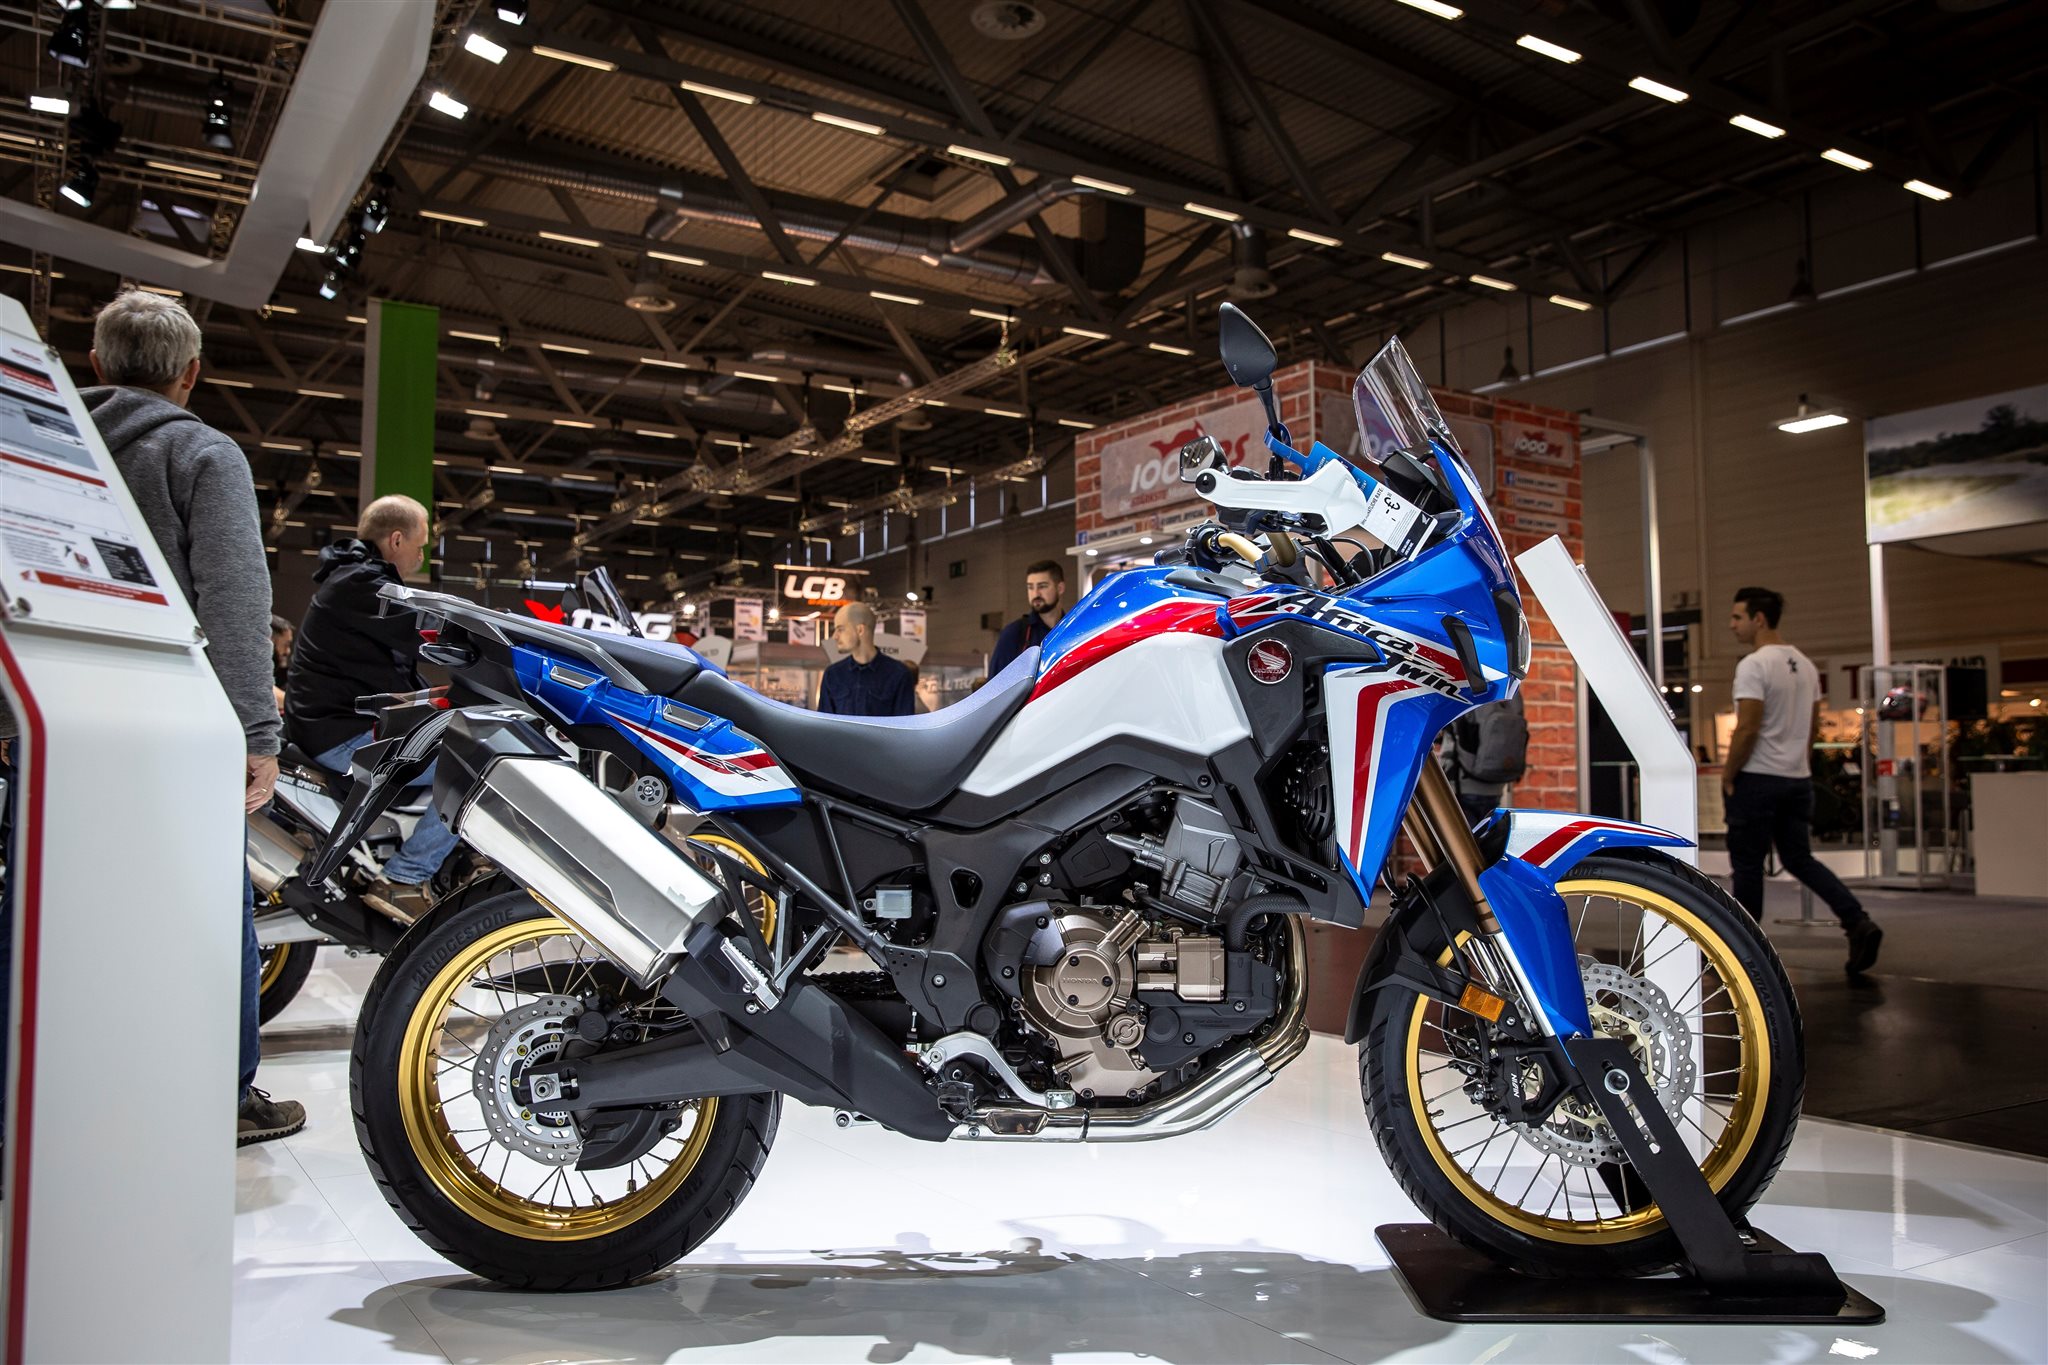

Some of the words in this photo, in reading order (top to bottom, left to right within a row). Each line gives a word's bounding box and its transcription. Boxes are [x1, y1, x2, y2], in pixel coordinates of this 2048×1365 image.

[784, 574, 846, 601] LCB
[1278, 594, 1415, 654] Africa
[1253, 667, 1286, 675] HONDA
[297, 779, 321, 792] SPORTS
[412, 907, 515, 993] BRIDGESTONE
[1061, 976, 1099, 985] HONDA
[1510, 1072, 1520, 1098] NISSIN
